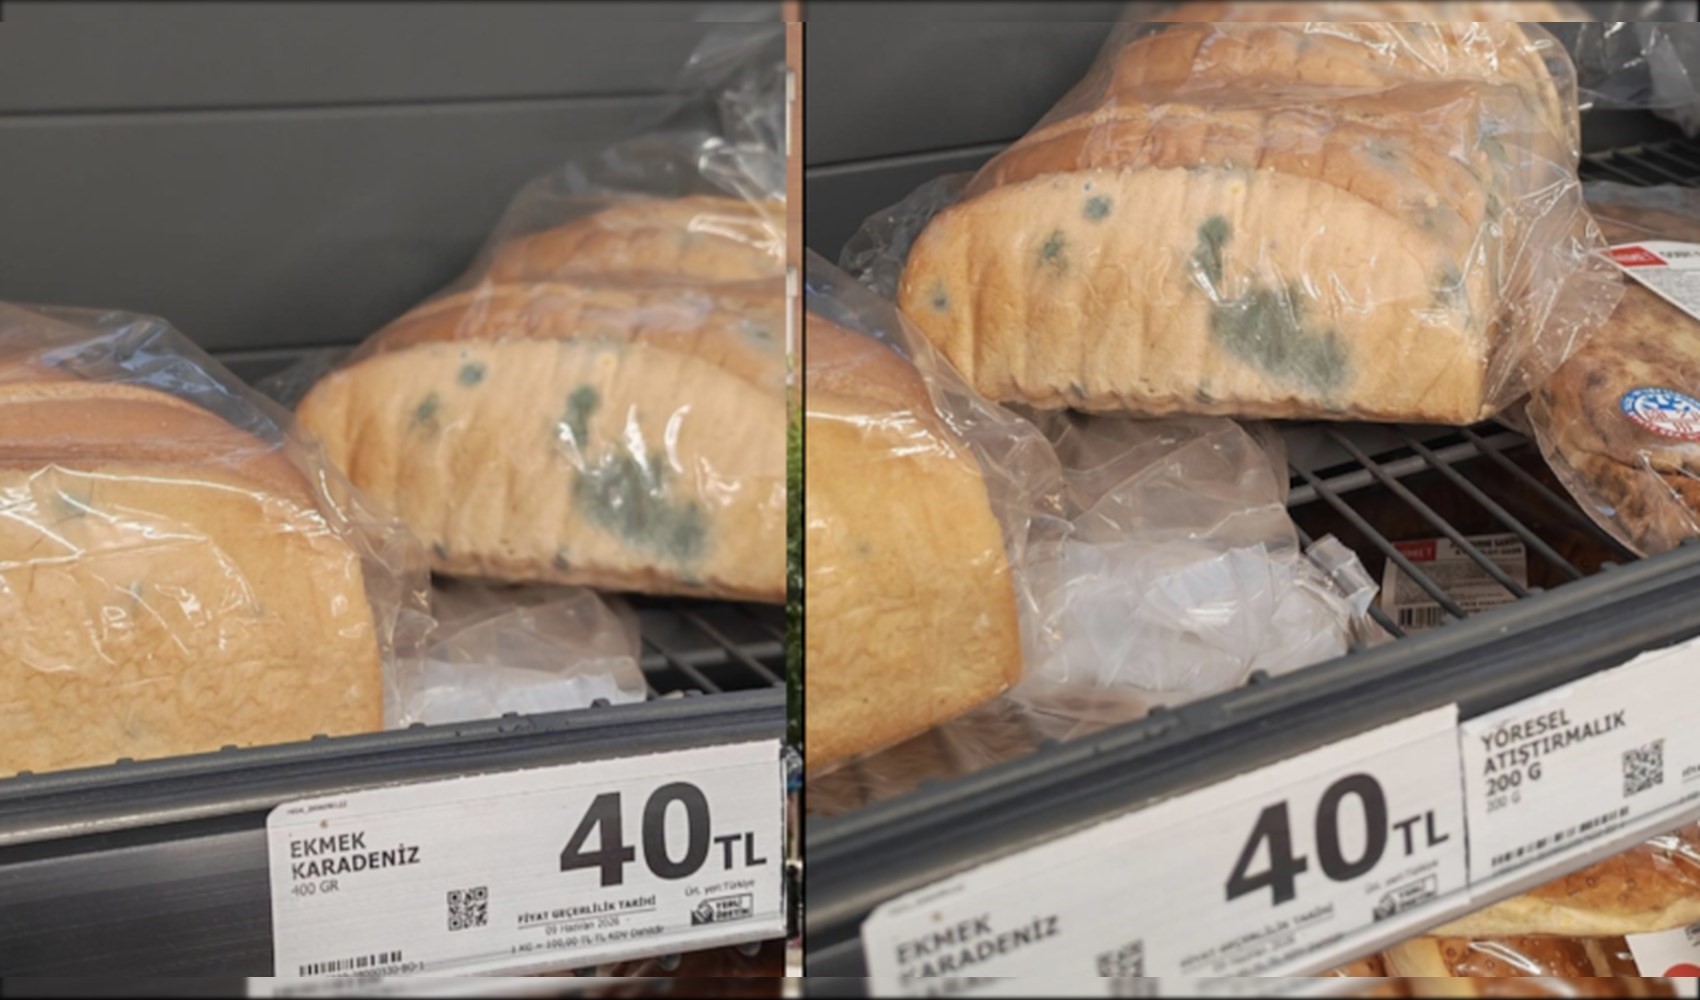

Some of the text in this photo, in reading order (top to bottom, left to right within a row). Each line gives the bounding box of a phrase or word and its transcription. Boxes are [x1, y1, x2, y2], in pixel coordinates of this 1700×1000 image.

[1481, 708, 1570, 751] YÖRESEL
[1484, 708, 1626, 776] ATIŞTIRMALIK
[1486, 761, 1542, 797] 200 G
[290, 831, 366, 859] EKMEK
[560, 781, 767, 887] 40 TL
[1225, 772, 1388, 907] 40
[1391, 810, 1450, 856] TL
[291, 843, 421, 880] KARADENİZ
[291, 879, 340, 897] 400 GR
[517, 894, 657, 924] FİYAT GEÇERLİLİK TARİHİ
[896, 911, 992, 965] EKMEK
